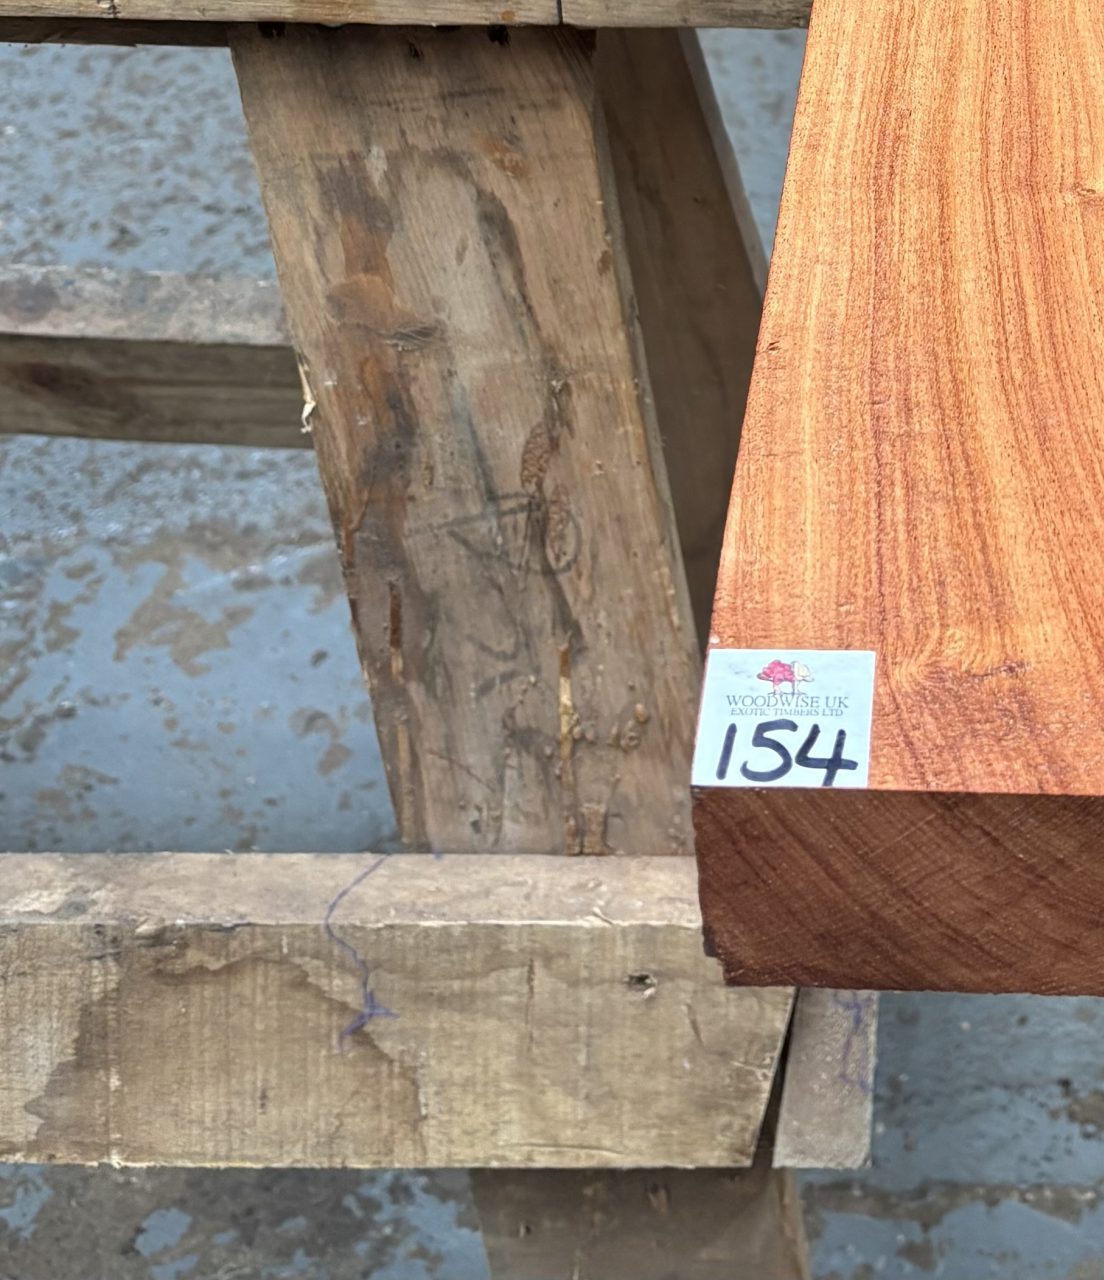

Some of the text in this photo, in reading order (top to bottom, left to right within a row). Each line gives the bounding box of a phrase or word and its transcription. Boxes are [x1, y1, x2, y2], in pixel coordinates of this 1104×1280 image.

[726, 695, 849, 709] WOODWISE UK
[730, 708, 843, 717] EXOTIC TIMBERS LTD
[716, 718, 858, 787] 154
